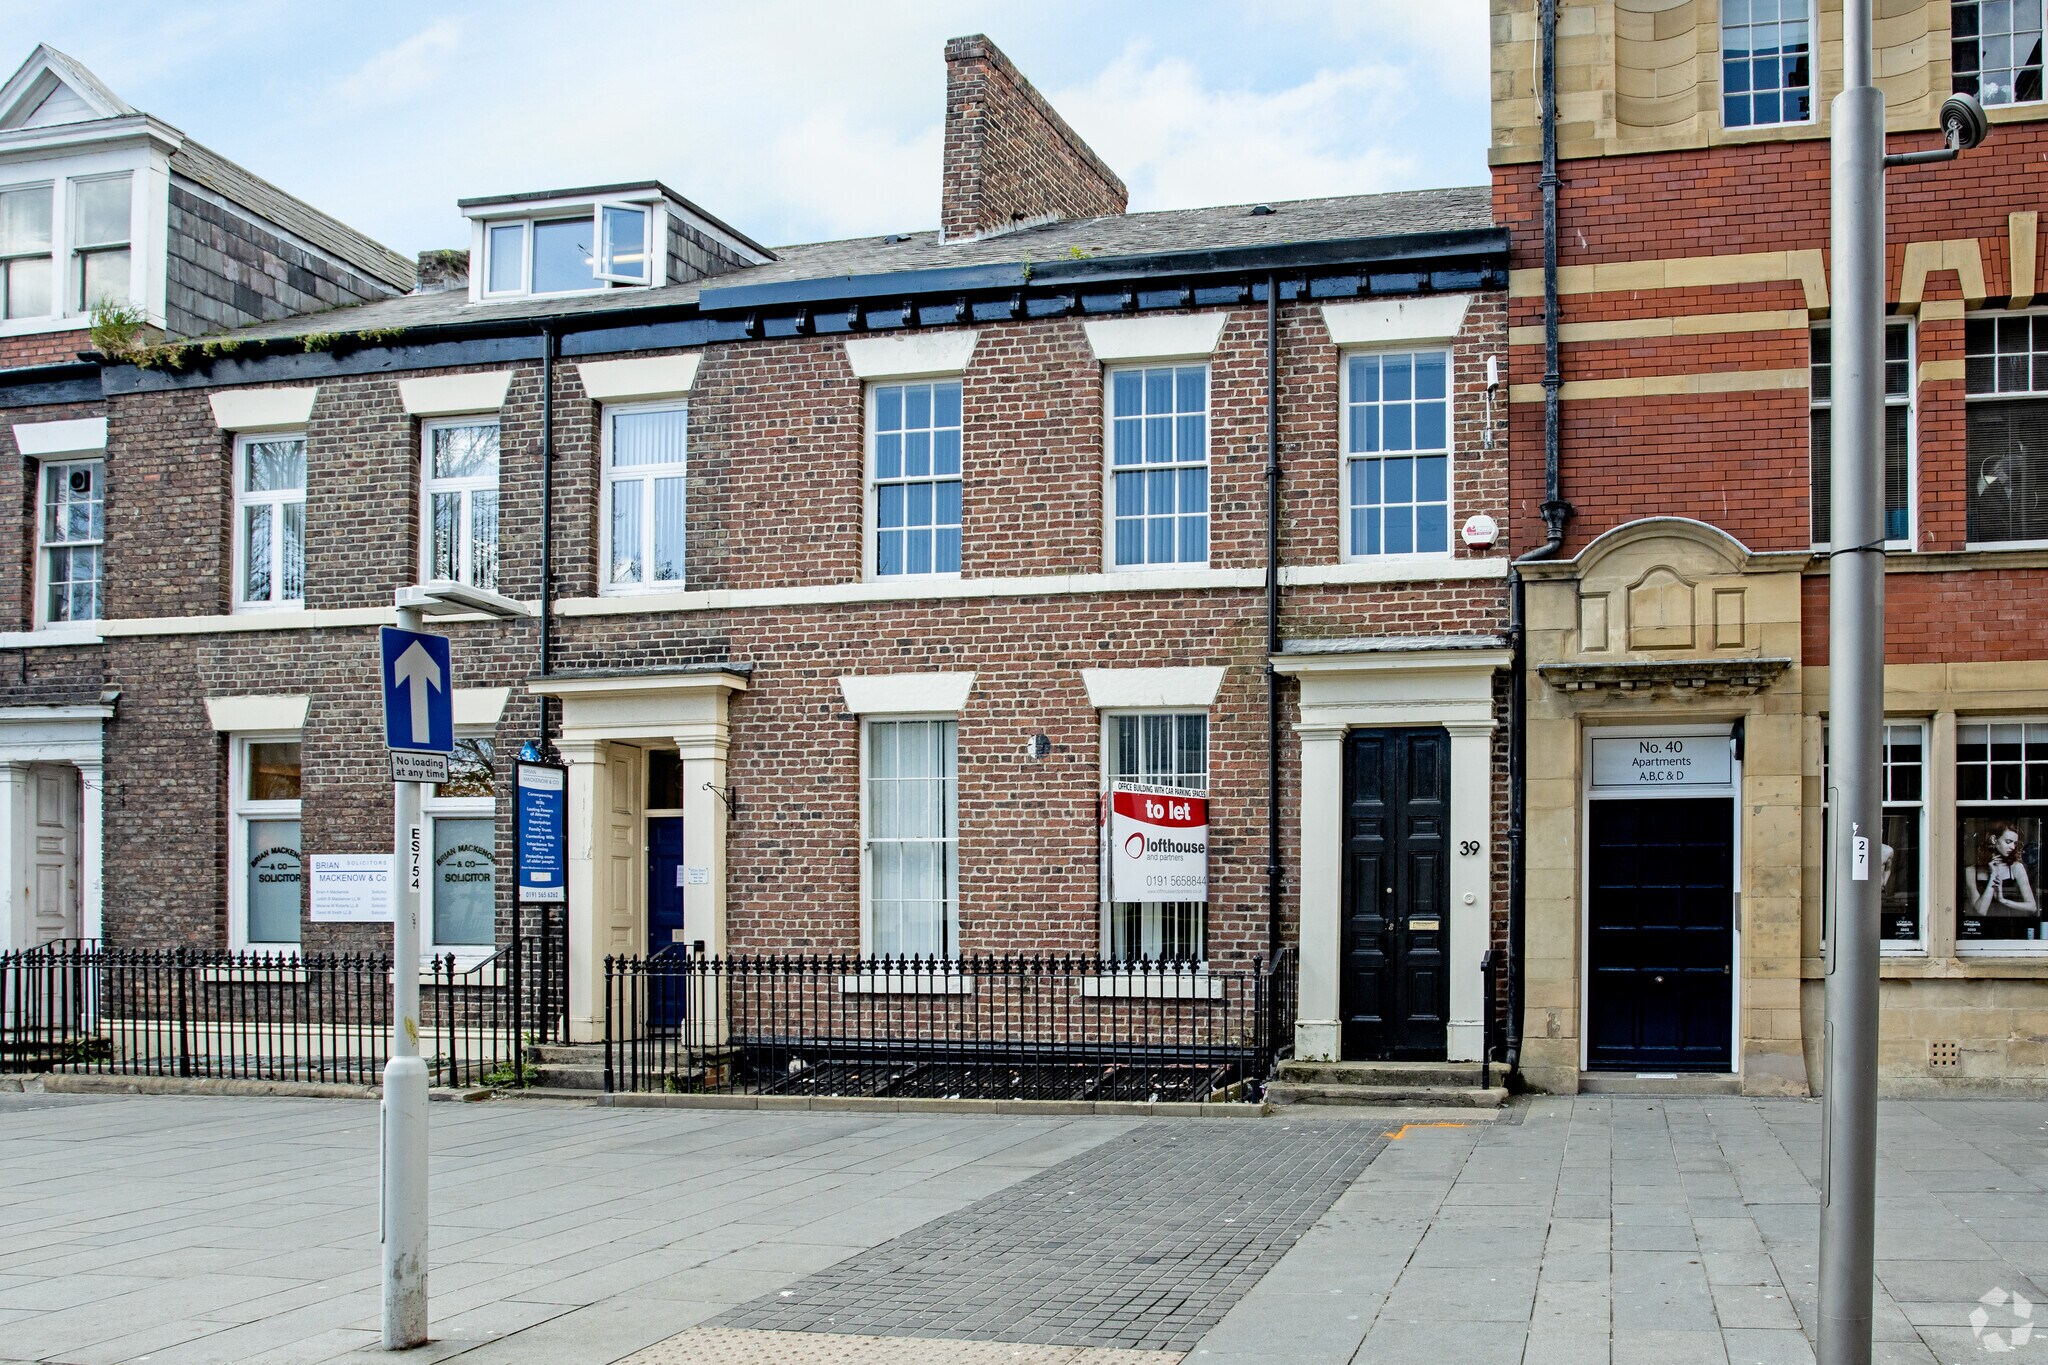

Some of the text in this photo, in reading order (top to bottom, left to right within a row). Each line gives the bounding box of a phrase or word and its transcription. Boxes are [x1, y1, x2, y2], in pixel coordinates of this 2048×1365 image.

[1640, 741, 1683, 753] No. 40
[396, 756, 444, 769] No loading
[1632, 757, 1691, 768] Apartments
[396, 768, 445, 778] at any time
[1640, 771, 1684, 781] A,B,C & D
[1118, 783, 1132, 791] OFFICE
[1134, 784, 1153, 793] BUILDING
[1155, 786, 1164, 794] WITH
[1175, 788, 1191, 796] PARKING
[1192, 790, 1206, 798] SPACES
[1146, 800, 1191, 820] to let
[1147, 838, 1205, 853] lofthouse
[1460, 841, 1480, 856] 39
[250, 850, 269, 868] BRIAN
[436, 848, 456, 866] BRIAN
[1160, 854, 1184, 862] partners
[259, 874, 301, 882] SOLICITOR
[445, 873, 490, 882] SOLICITOR
[1147, 875, 1207, 886] 0191 5658844
